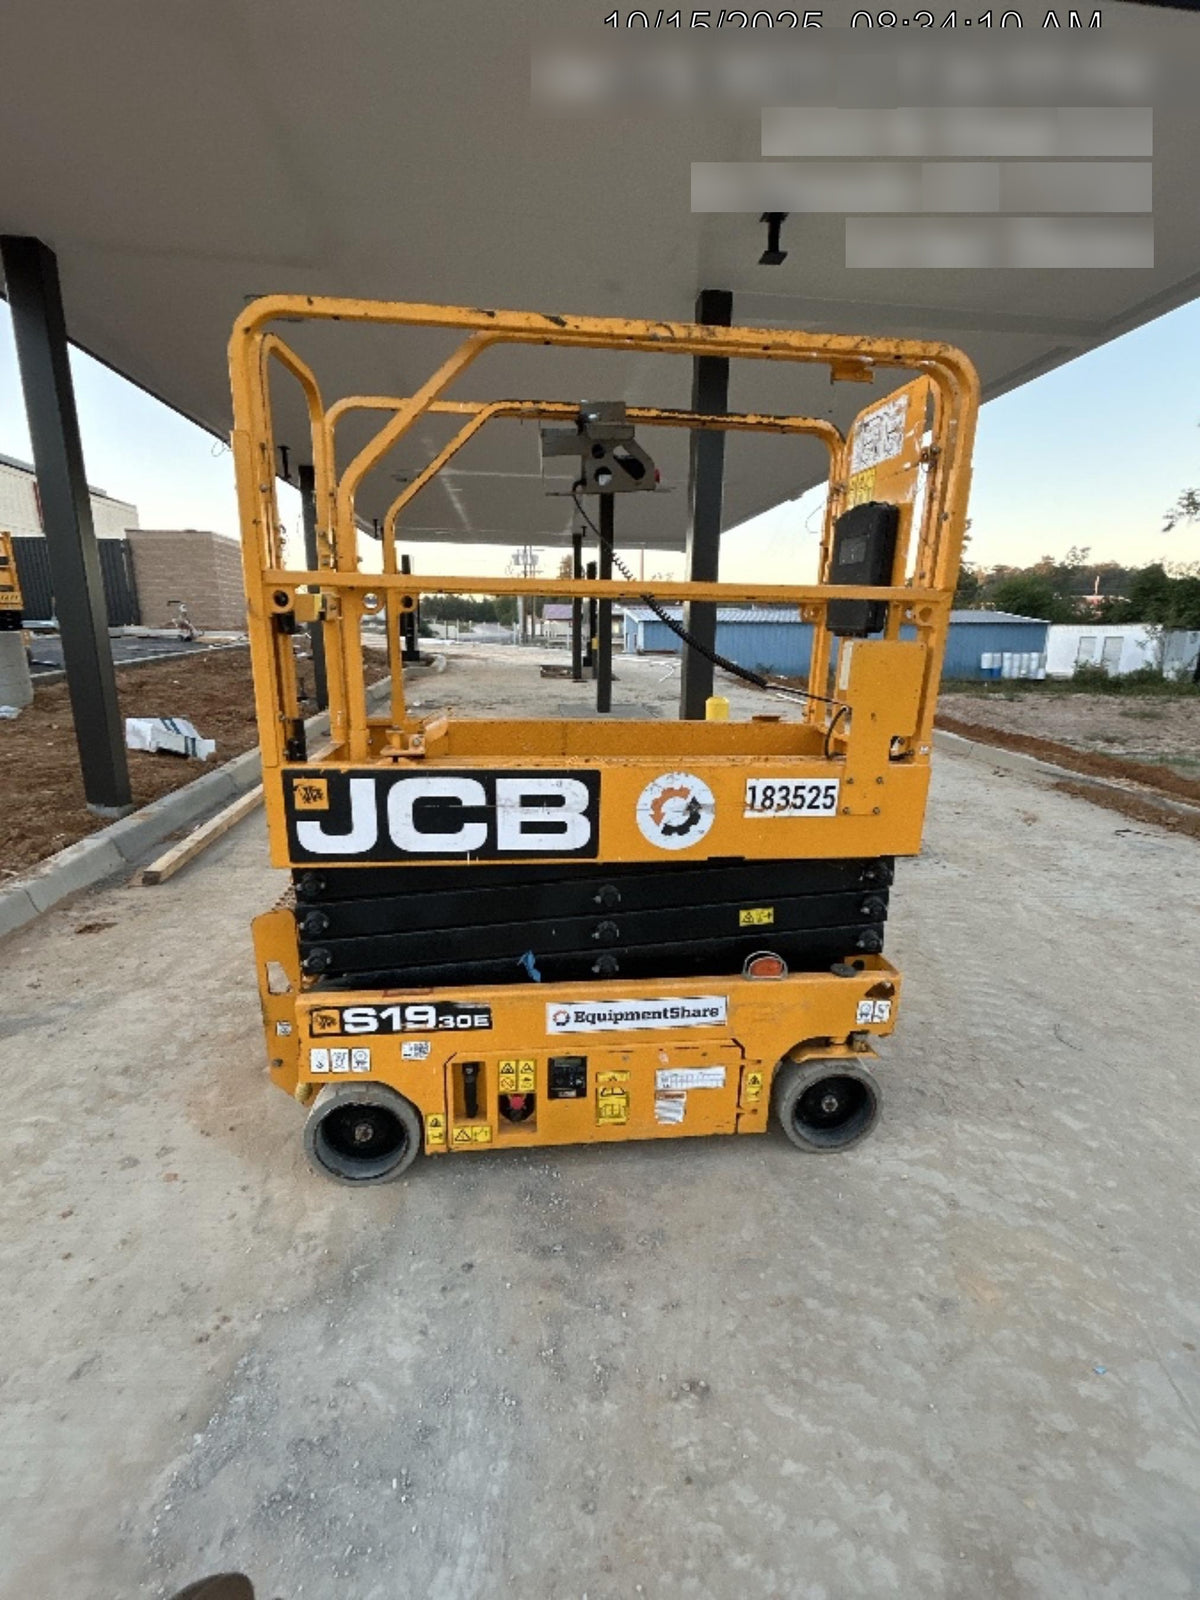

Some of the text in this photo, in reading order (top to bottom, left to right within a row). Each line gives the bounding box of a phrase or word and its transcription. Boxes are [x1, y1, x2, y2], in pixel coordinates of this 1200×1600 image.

[748, 785, 836, 812] 183525
[296, 776, 592, 855] JCB
[573, 1006, 720, 1025] EquipmentShare
